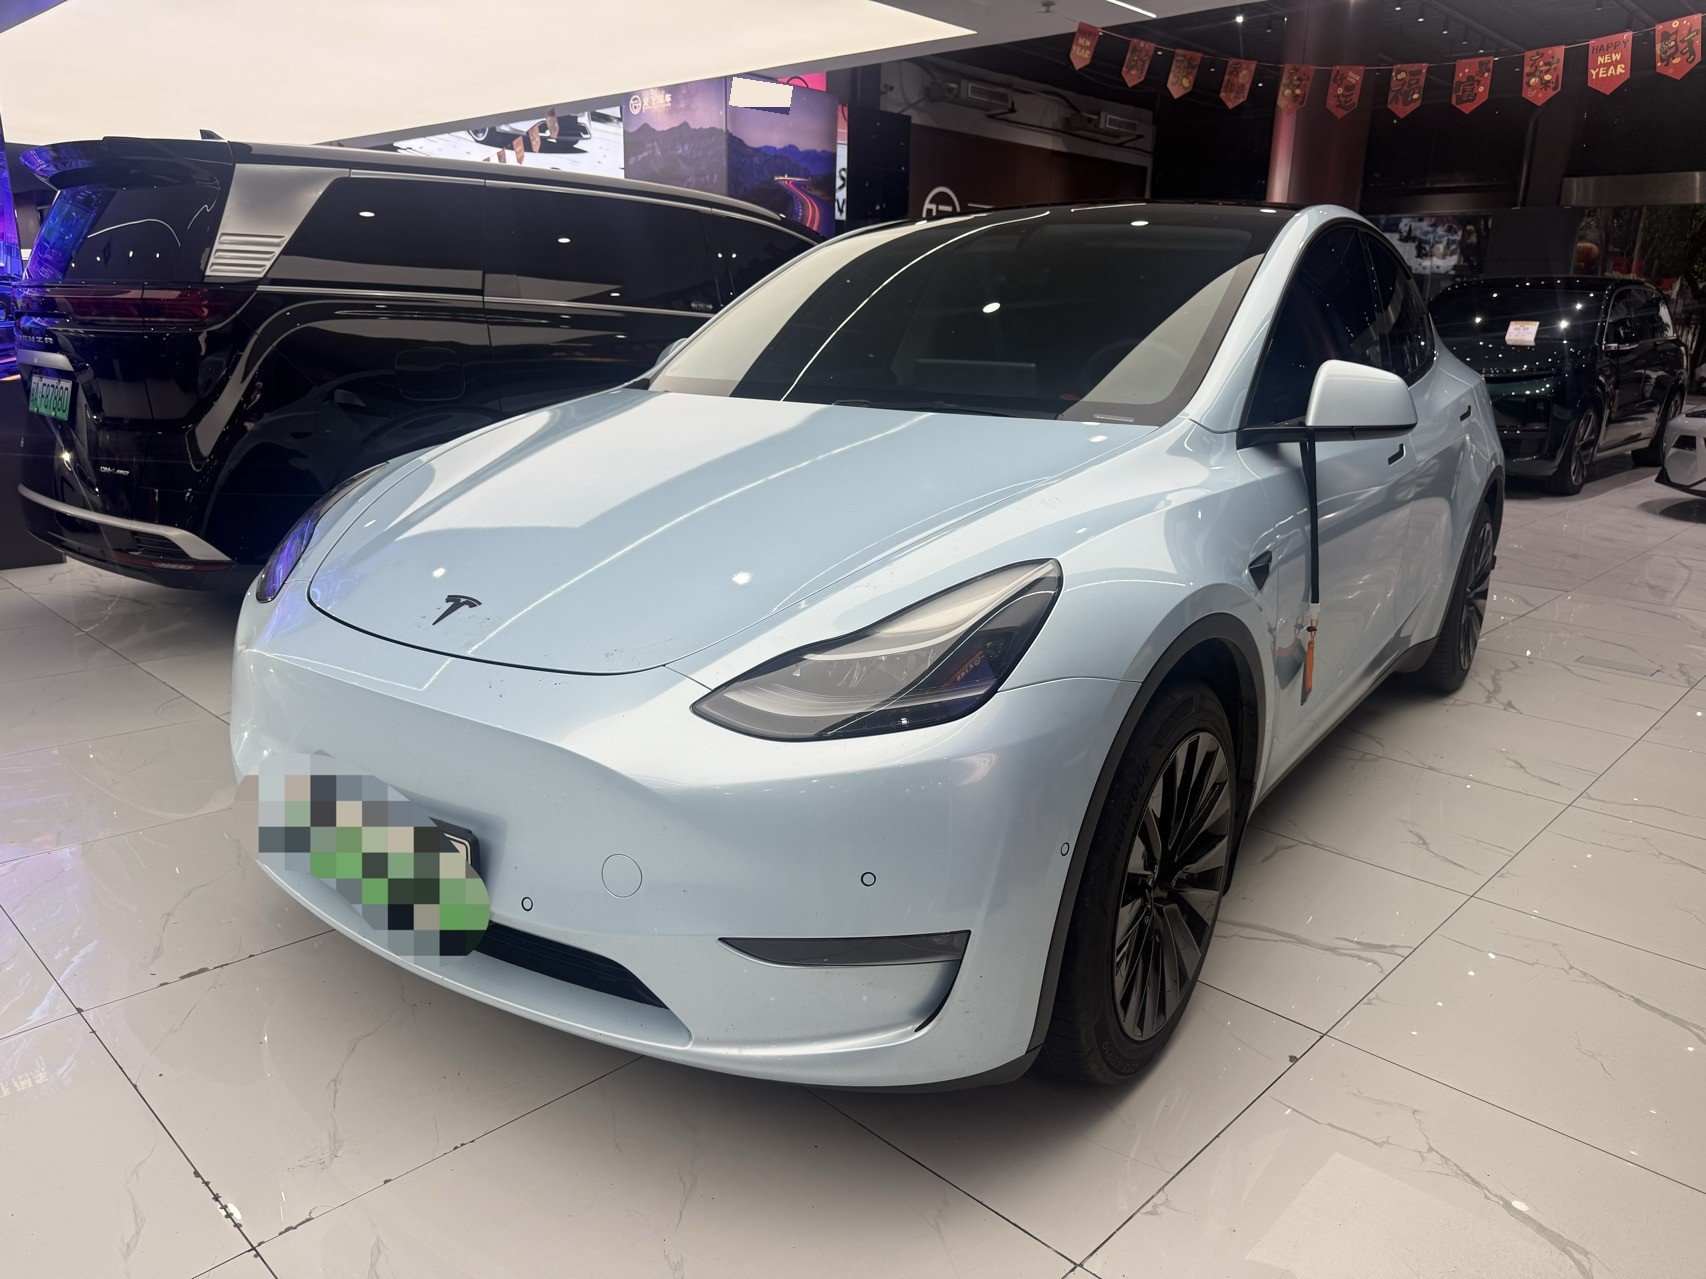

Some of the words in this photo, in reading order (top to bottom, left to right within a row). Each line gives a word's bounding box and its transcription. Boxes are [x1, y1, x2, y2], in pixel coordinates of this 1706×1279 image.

[1591, 38, 1630, 55] HAPPY
[1597, 51, 1621, 65] NEW
[1590, 63, 1626, 79] YEAR
[1388, 69, 1423, 106] 福
